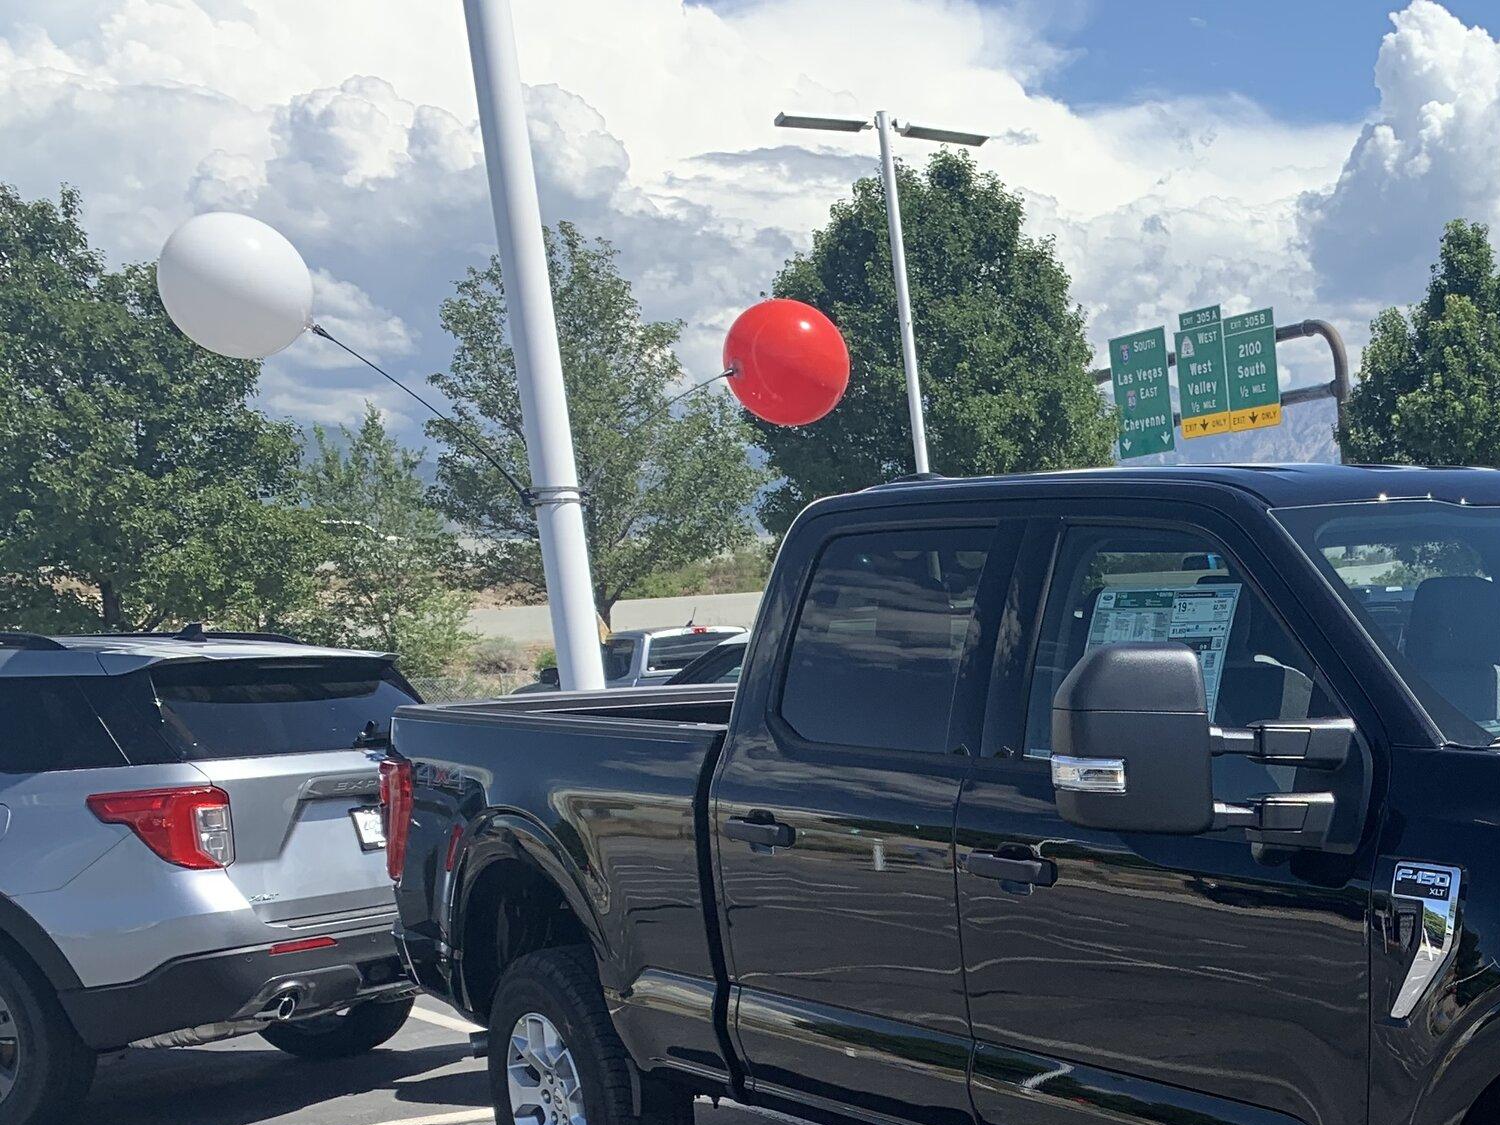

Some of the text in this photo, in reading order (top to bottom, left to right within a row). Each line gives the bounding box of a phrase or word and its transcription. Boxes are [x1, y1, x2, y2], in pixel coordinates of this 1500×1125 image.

[1197, 331, 1217, 344] WEST
[1133, 339, 1156, 353] SOUTH
[1238, 341, 1262, 358] 2100
[1189, 360, 1212, 376] West
[1237, 361, 1266, 379] South
[1117, 367, 1163, 386] Las Vegas
[1140, 387, 1157, 400] EAST
[1187, 381, 1217, 396] Valley
[1252, 383, 1267, 394] MILE
[1203, 400, 1216, 409] MILE
[1124, 414, 1166, 432] Cheyenne
[1233, 410, 1278, 425] EXIT ONLY
[1185, 418, 1227, 433] EXIT ONLY
[1178, 601, 1187, 613] 19
[1396, 868, 1450, 888] F-150
[1429, 887, 1445, 896] XLT
